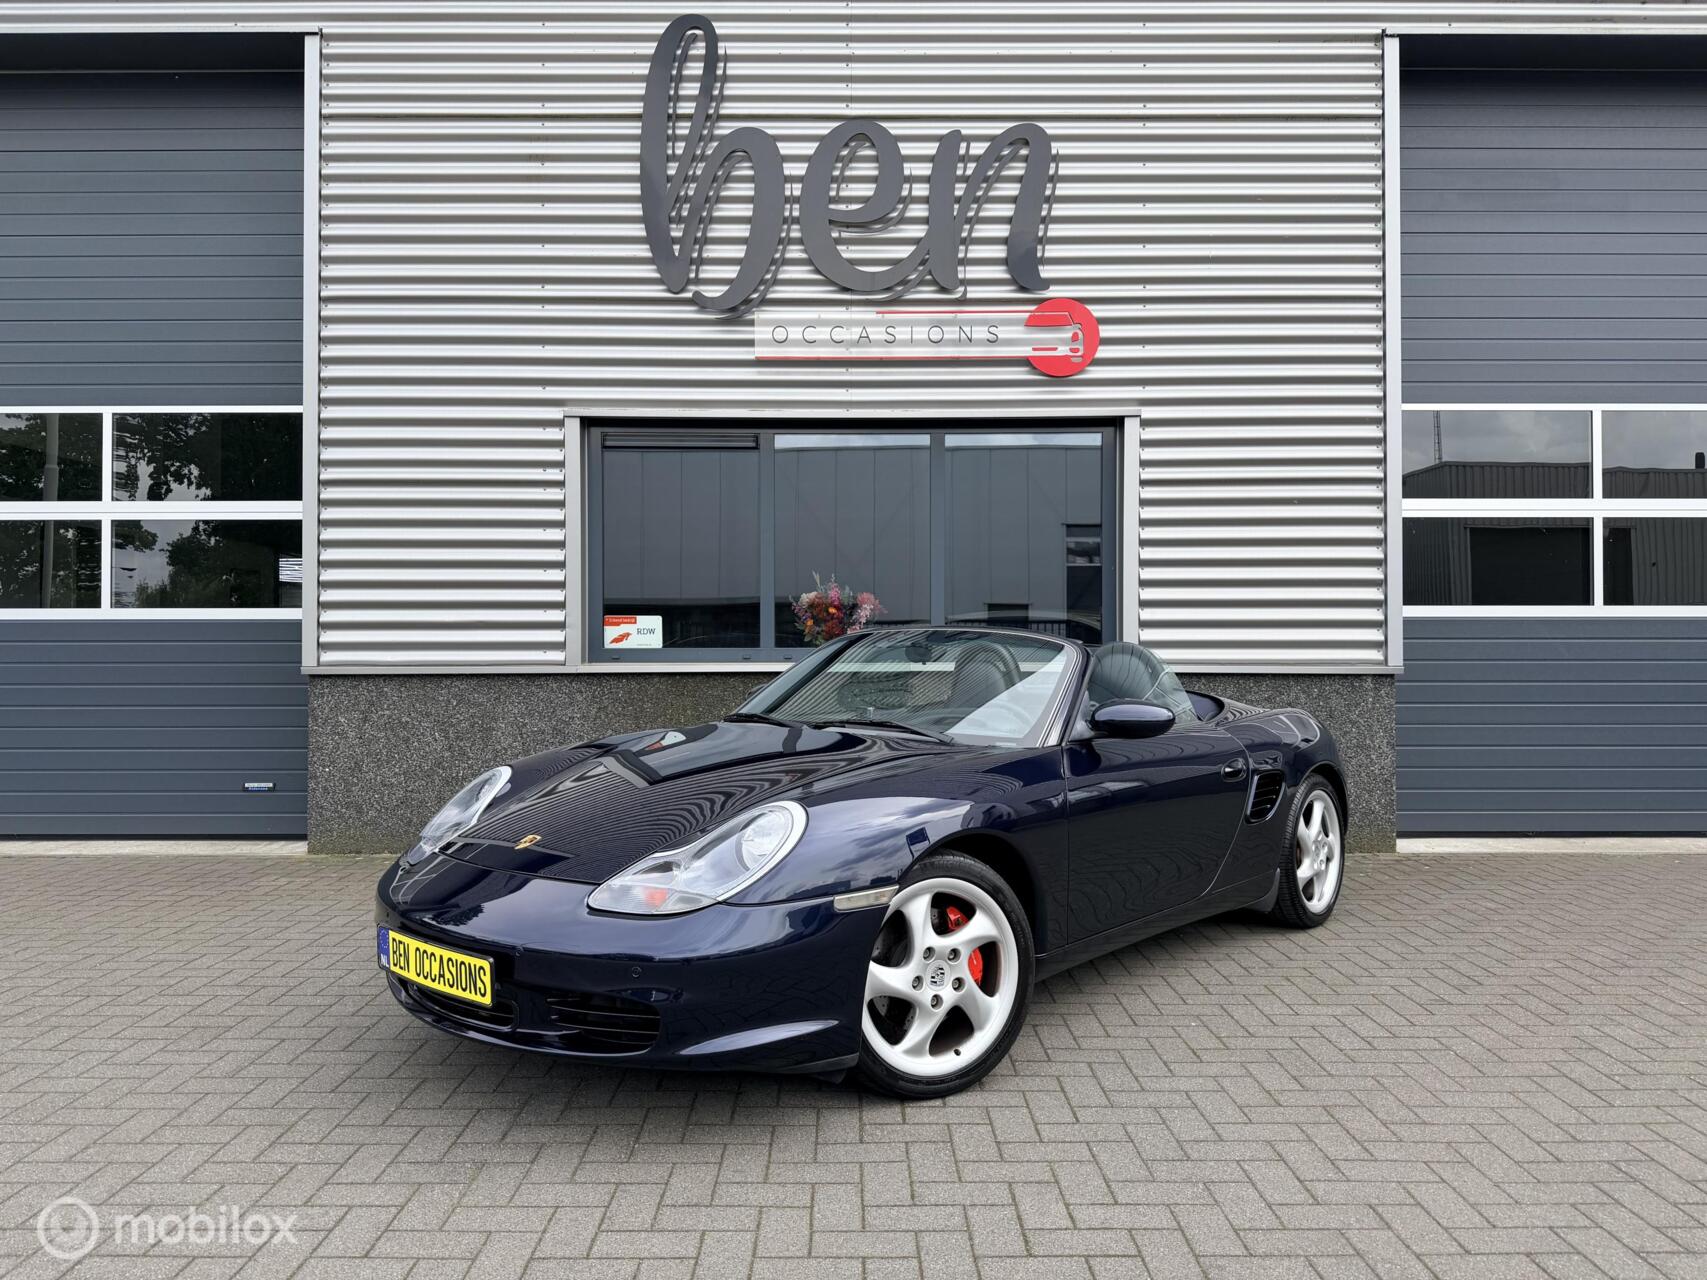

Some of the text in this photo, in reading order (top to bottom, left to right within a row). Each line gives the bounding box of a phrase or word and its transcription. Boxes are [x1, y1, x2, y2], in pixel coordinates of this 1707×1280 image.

[640, 13, 1052, 311] ben
[771, 324, 1000, 345] OCCASIONS
[637, 627, 656, 635] RDW
[380, 953, 390, 968] NL
[391, 936, 487, 998] BEN OCCASIONS
